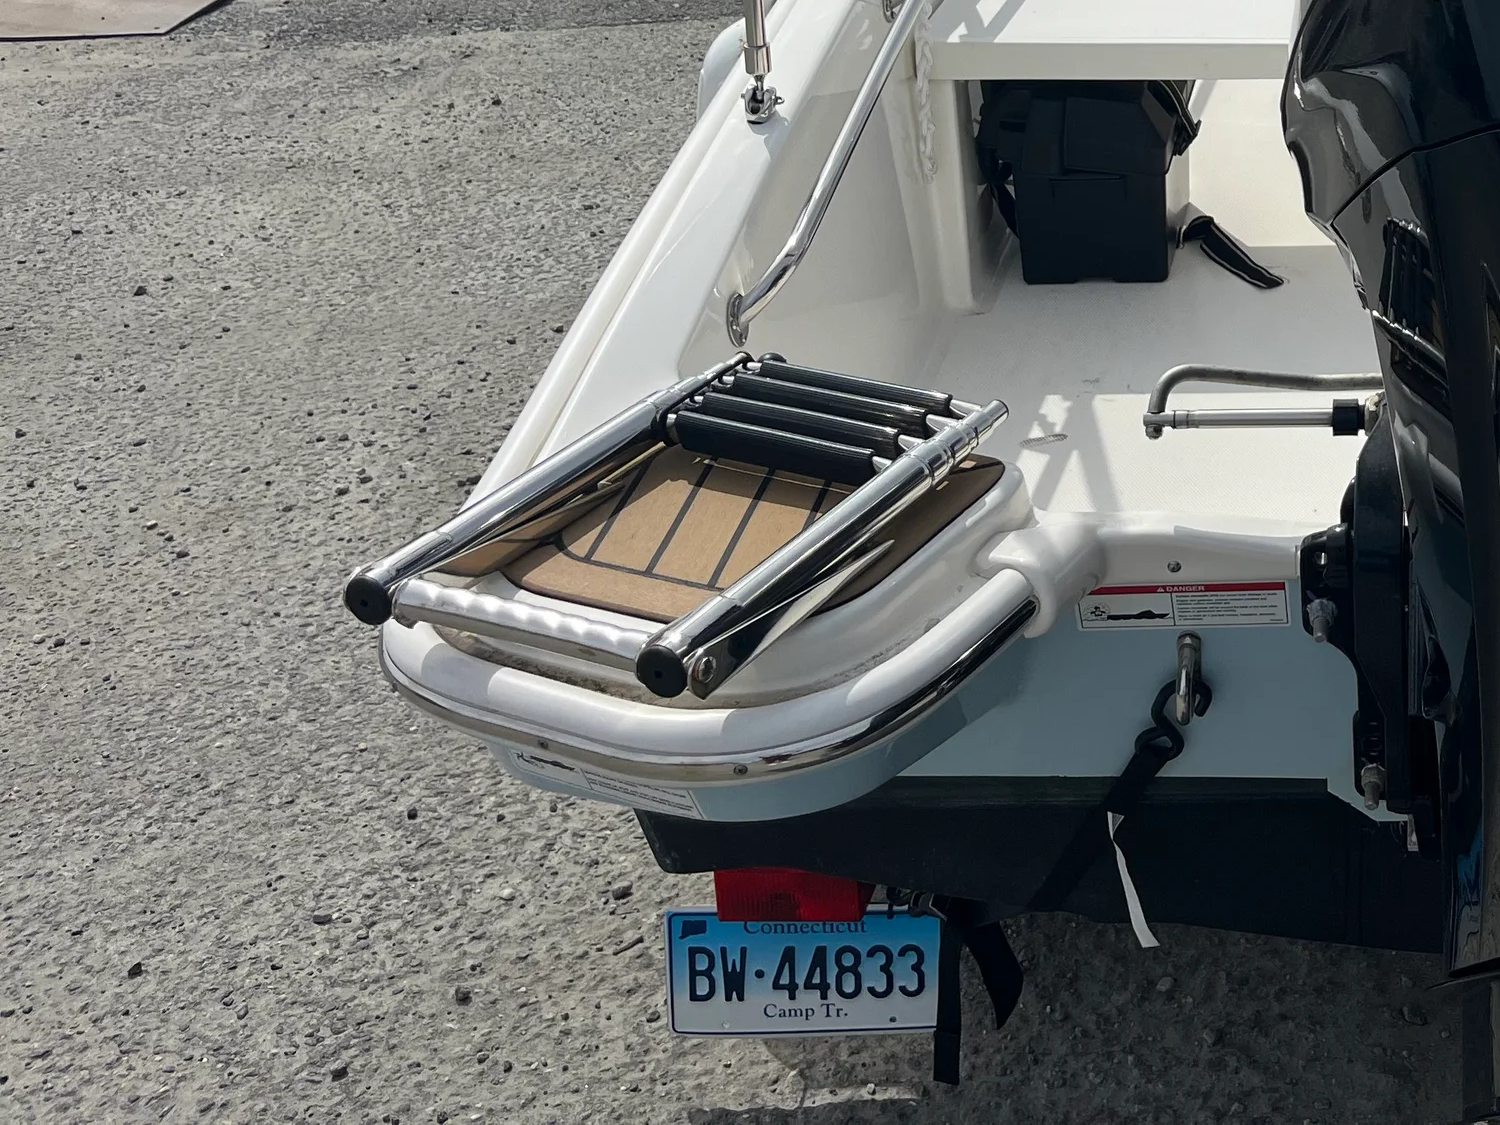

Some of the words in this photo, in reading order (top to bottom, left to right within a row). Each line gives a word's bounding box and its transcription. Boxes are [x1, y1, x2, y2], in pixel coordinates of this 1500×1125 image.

[1165, 585, 1206, 593] DANGER
[743, 921, 867, 935] Connecticut
[763, 1003, 815, 1021] Camp
[820, 1003, 849, 1018] Tr.
